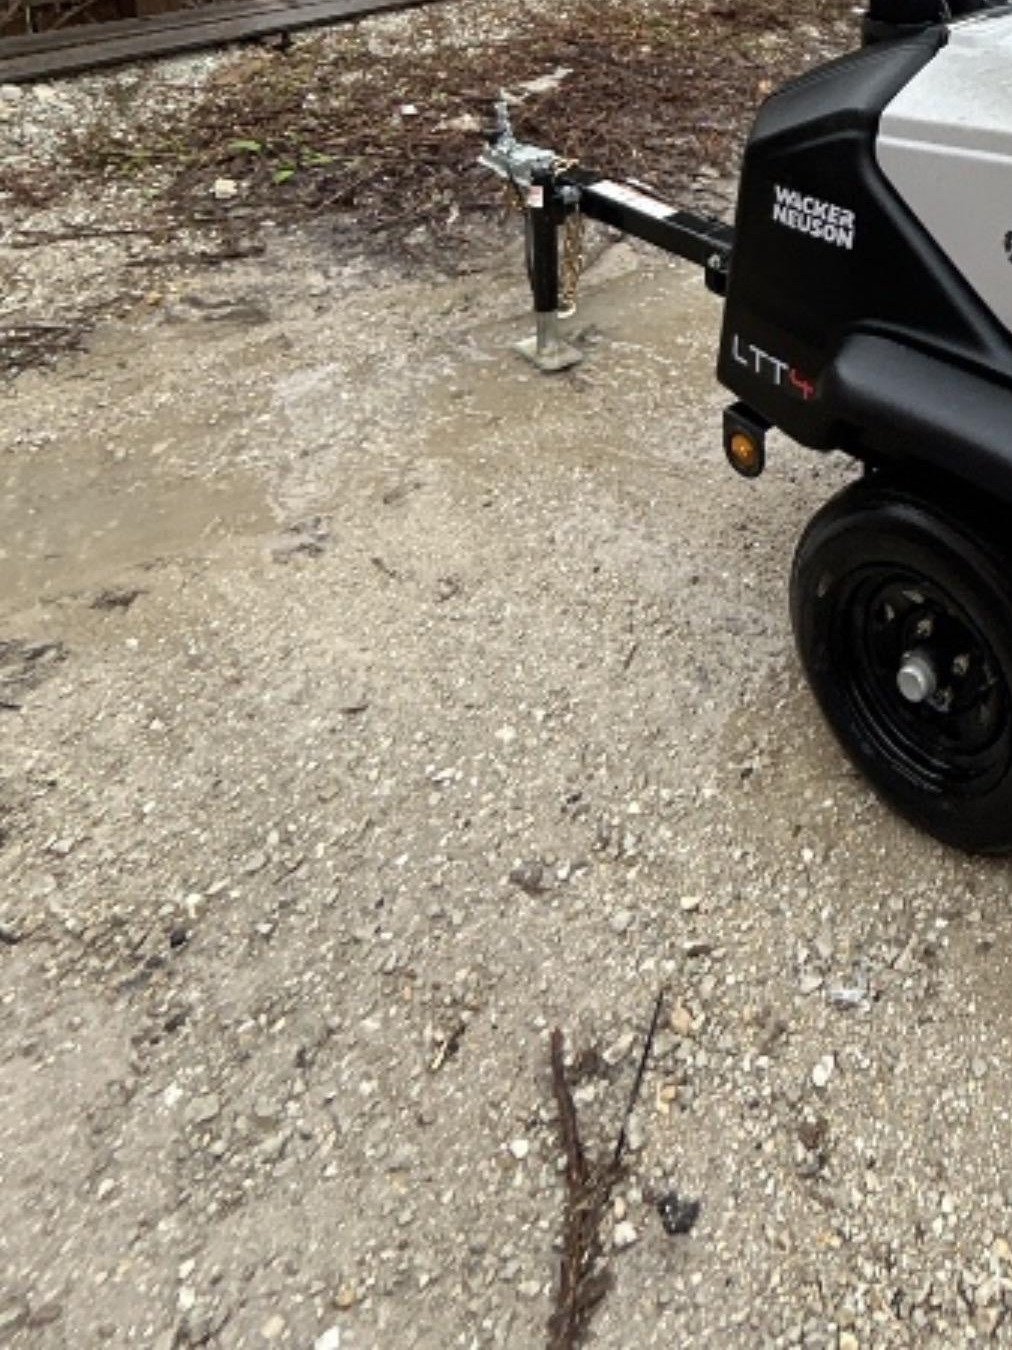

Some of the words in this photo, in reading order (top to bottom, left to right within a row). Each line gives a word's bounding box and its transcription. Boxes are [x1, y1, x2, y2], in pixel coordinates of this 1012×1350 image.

[773, 203, 854, 250] NEUSON
[774, 184, 856, 229] WACKER
[733, 334, 814, 400] LTT4
